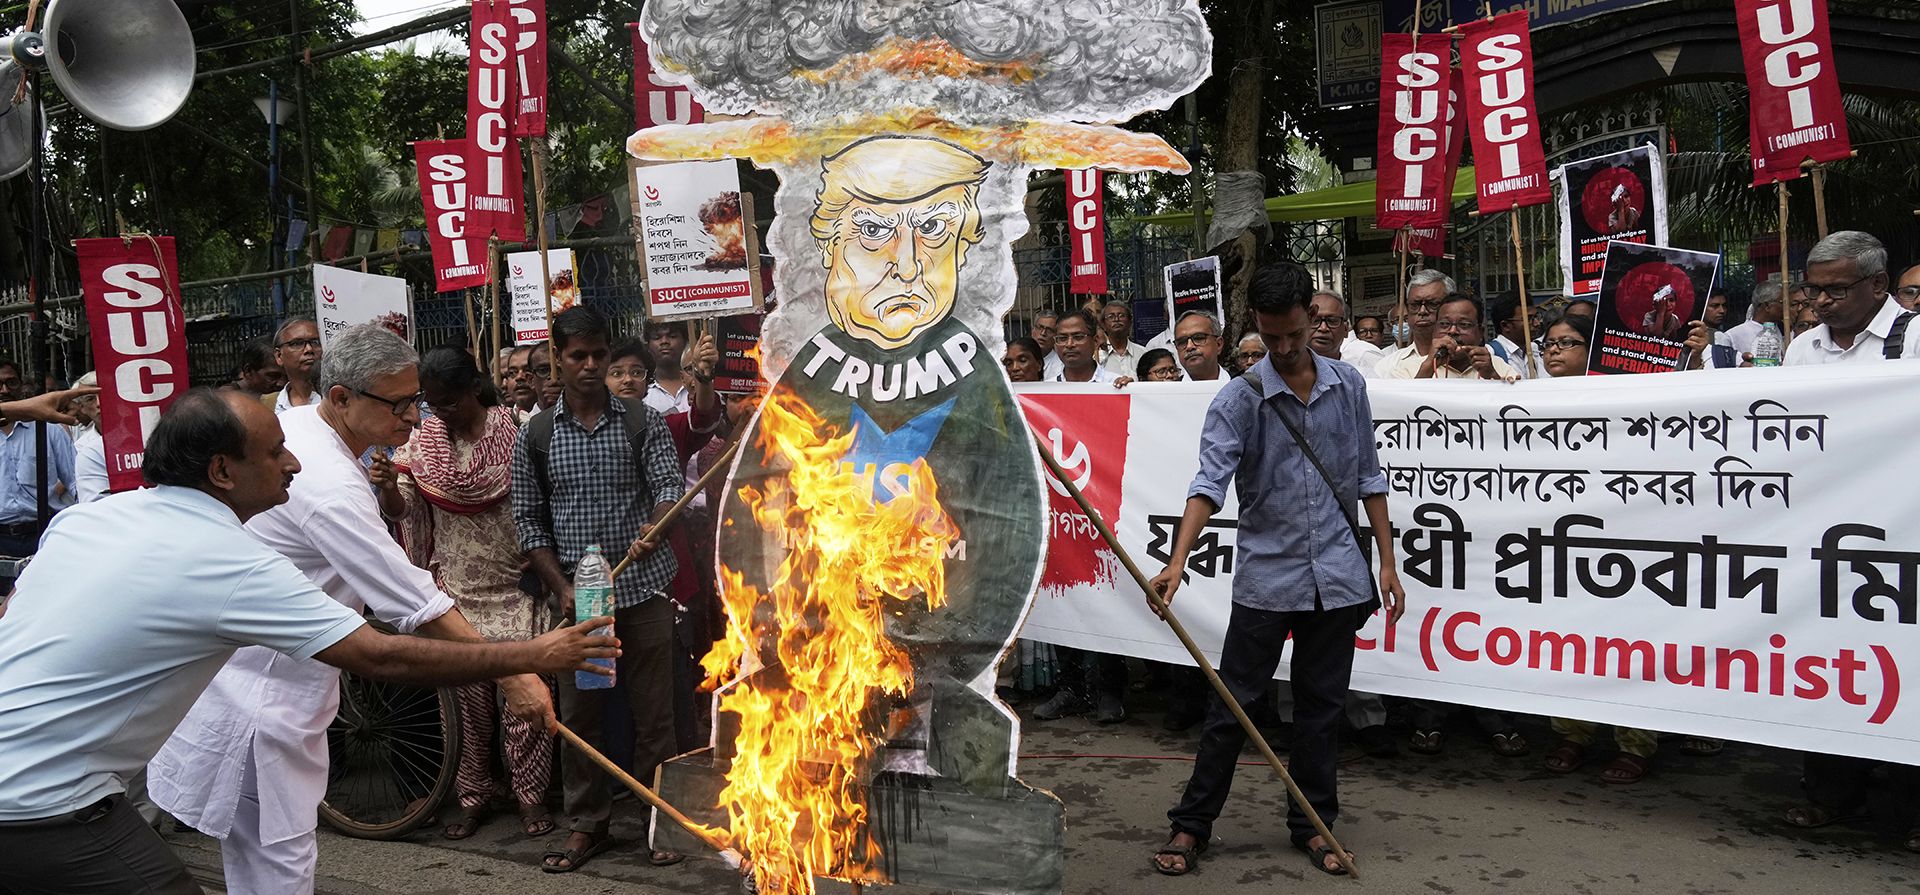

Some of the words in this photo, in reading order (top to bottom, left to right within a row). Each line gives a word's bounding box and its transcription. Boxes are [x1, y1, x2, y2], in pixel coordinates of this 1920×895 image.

[477, 22, 507, 196] SUCI
[1393, 52, 1440, 198] SUCI
[1477, 33, 1529, 178] SUCI
[428, 154, 470, 266] SUCI
[1071, 168, 1097, 263] UCI
[1582, 253, 1596, 261] and
[658, 288, 687, 301] SUCI
[688, 284, 745, 298] (COMMUNIST)
[102, 263, 175, 450] SUCI
[521, 331, 539, 339] SUCI
[726, 350, 742, 358] and
[1602, 346, 1620, 354] and
[1621, 349, 1646, 360] stand
[1646, 355, 1679, 367] against
[1603, 335, 1660, 356] HIROSHIMA
[1662, 346, 1683, 360] DAY
[1605, 327, 1616, 335] Let
[1625, 331, 1641, 340] take
[1648, 335, 1674, 347] pledge
[803, 332, 977, 402] TRUMP
[1497, 404, 1611, 451] দিবসে
[1627, 411, 1732, 452] শপথ
[1745, 399, 1829, 453] নিন
[1601, 468, 1696, 507] কবর
[1709, 455, 1794, 511] দিন
[1495, 513, 1788, 610] প্রতিবাদ
[1419, 606, 1901, 725] (Communist)
